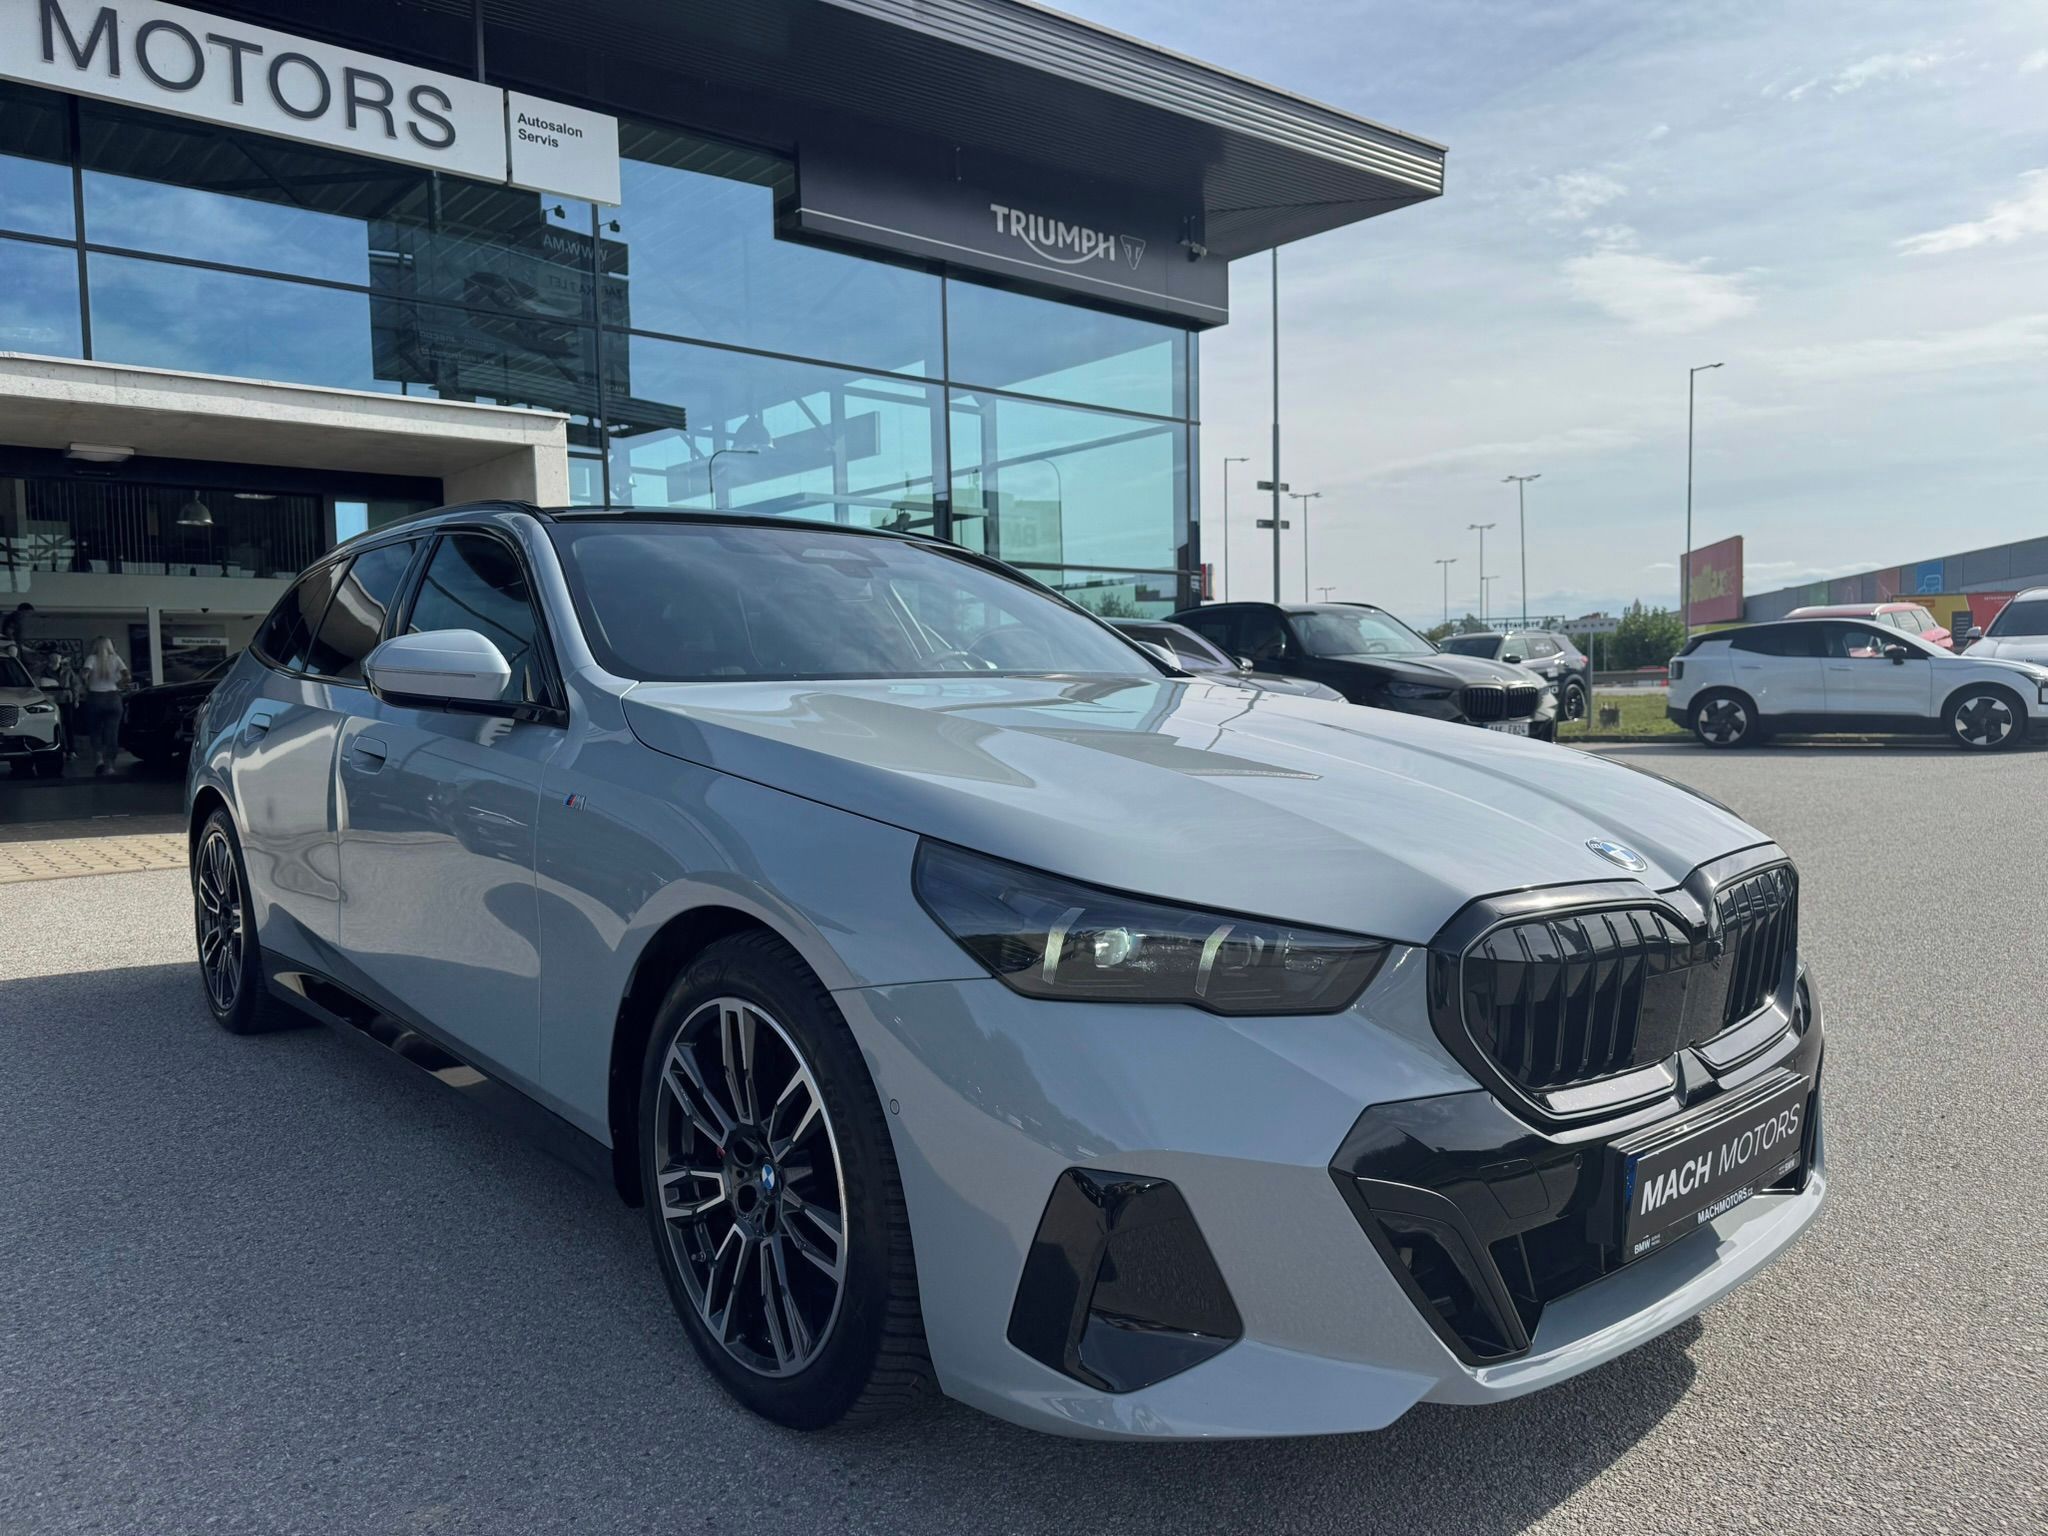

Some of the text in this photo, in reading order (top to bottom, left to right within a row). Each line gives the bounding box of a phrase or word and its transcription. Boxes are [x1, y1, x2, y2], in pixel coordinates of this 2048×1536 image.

[40, 0, 457, 150] MOTORS
[516, 112, 584, 138] Autosalon
[517, 129, 560, 149] Servis
[990, 203, 1116, 264] TRIUMPH
[1640, 1102, 1801, 1216] MACH MOTORS
[1634, 1237, 1652, 1255] BMW
